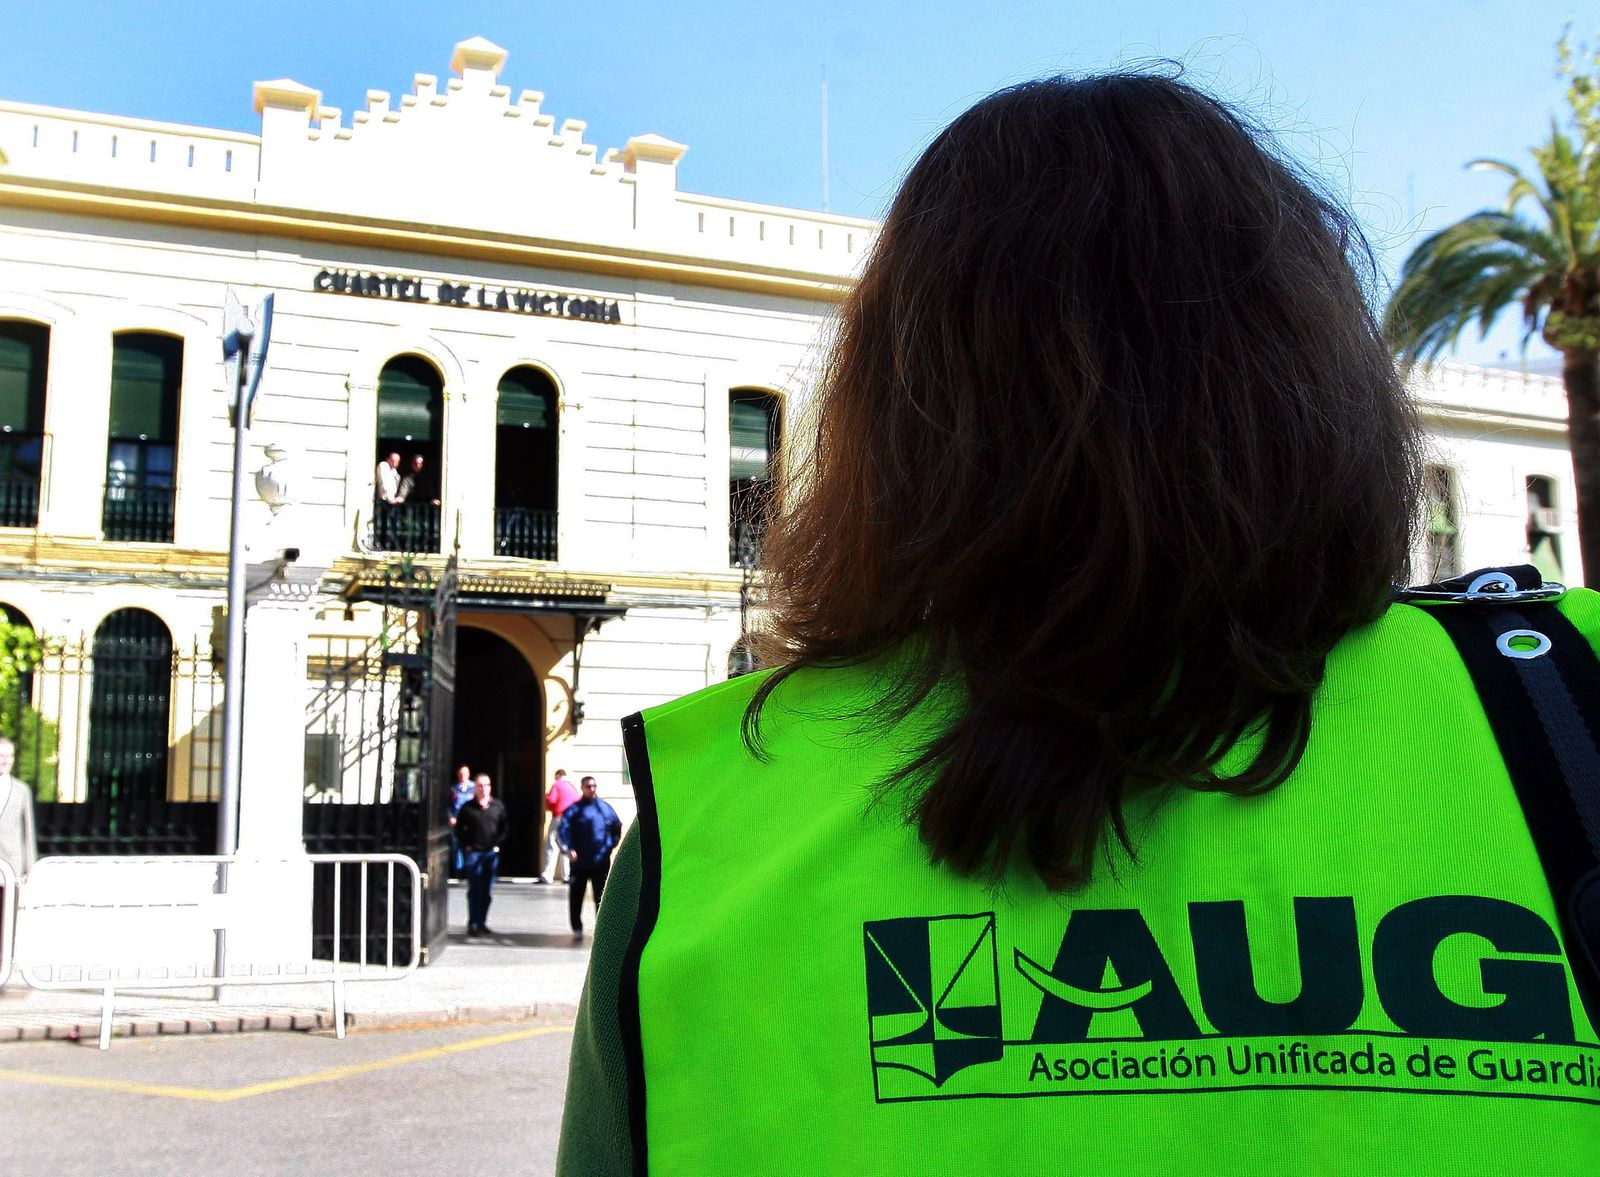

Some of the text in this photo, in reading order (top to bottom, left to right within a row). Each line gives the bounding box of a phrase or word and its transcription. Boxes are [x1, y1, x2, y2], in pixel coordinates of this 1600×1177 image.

[314, 269, 621, 322] CUARTEL DE LA VICTORIA
[1029, 1042, 1600, 1089] Asociación Unificada de Guardi
